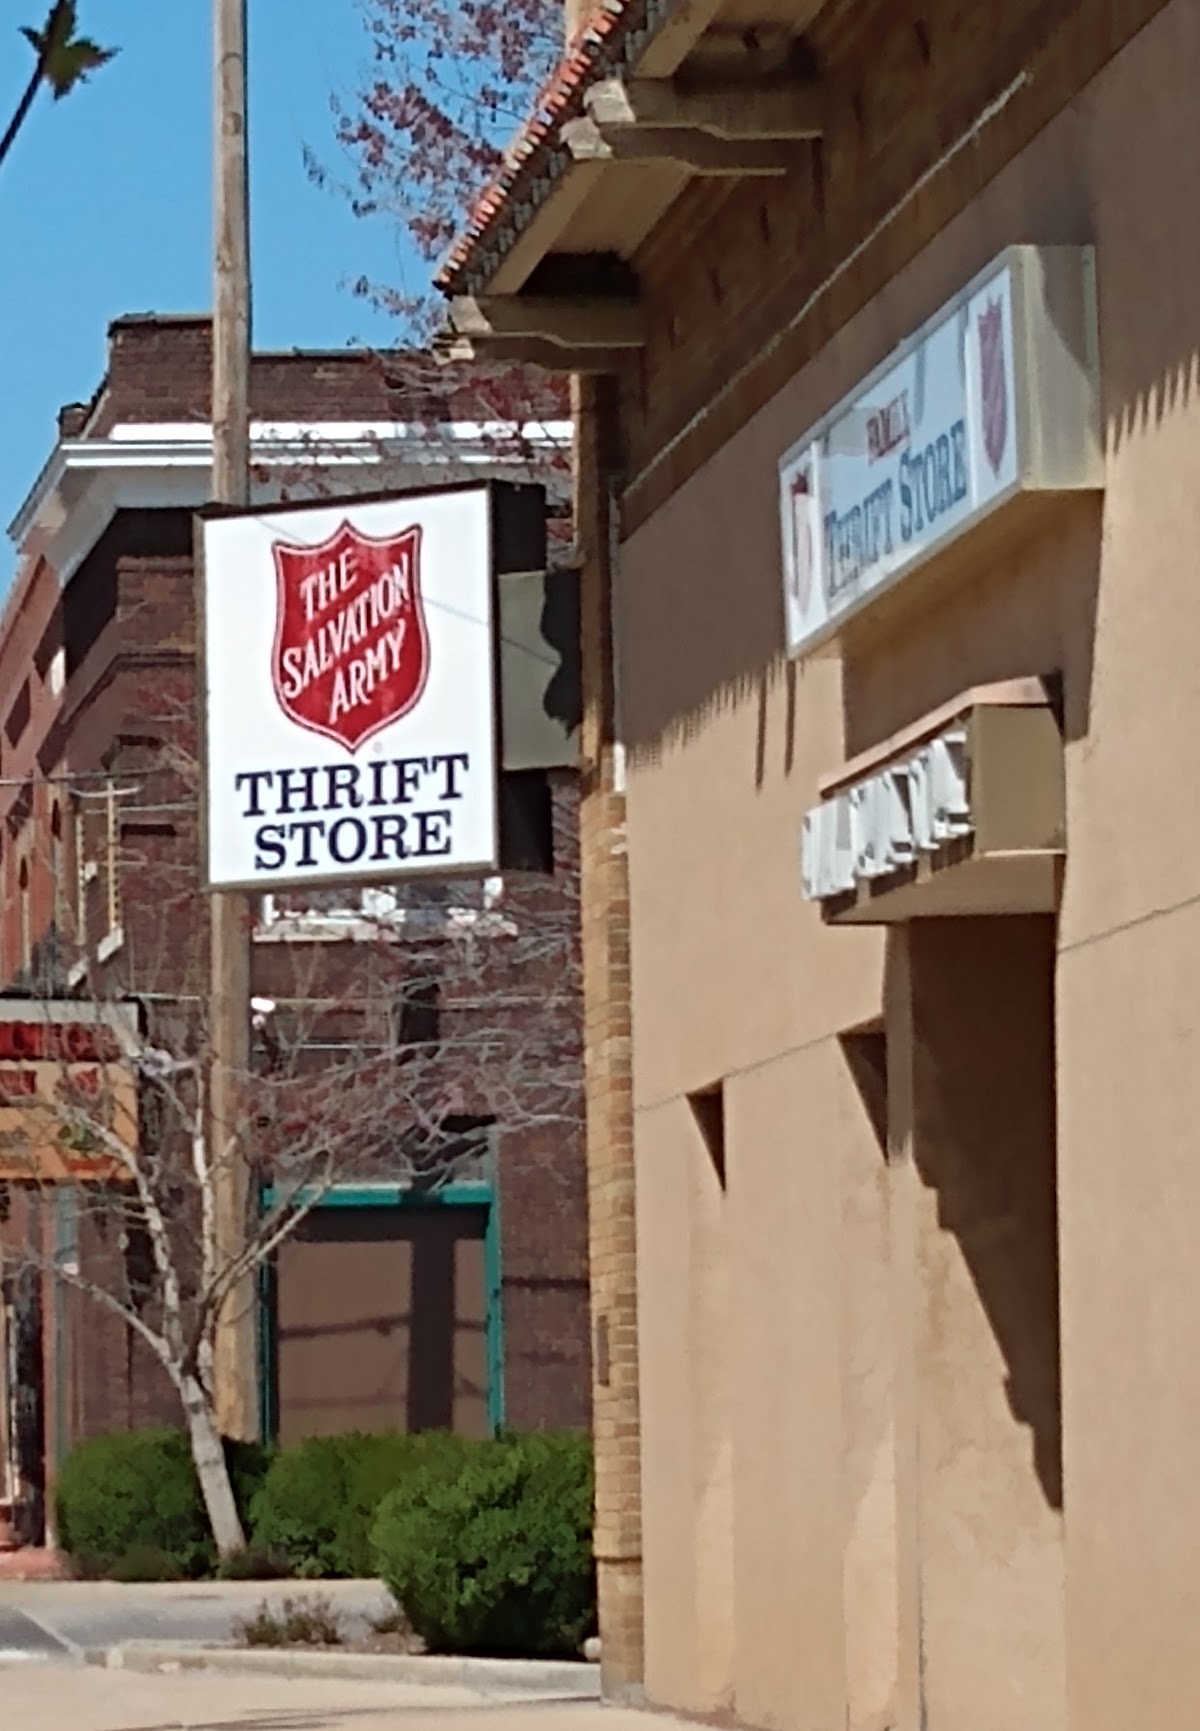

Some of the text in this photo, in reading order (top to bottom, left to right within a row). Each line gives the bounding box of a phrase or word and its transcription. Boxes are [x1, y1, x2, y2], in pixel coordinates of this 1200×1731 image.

[899, 420, 967, 542] STORE
[282, 553, 410, 699] SALVATION
[300, 549, 358, 622] THE
[328, 619, 405, 724] ARMY
[235, 753, 469, 817] THRIFT
[254, 810, 452, 870] STORE
